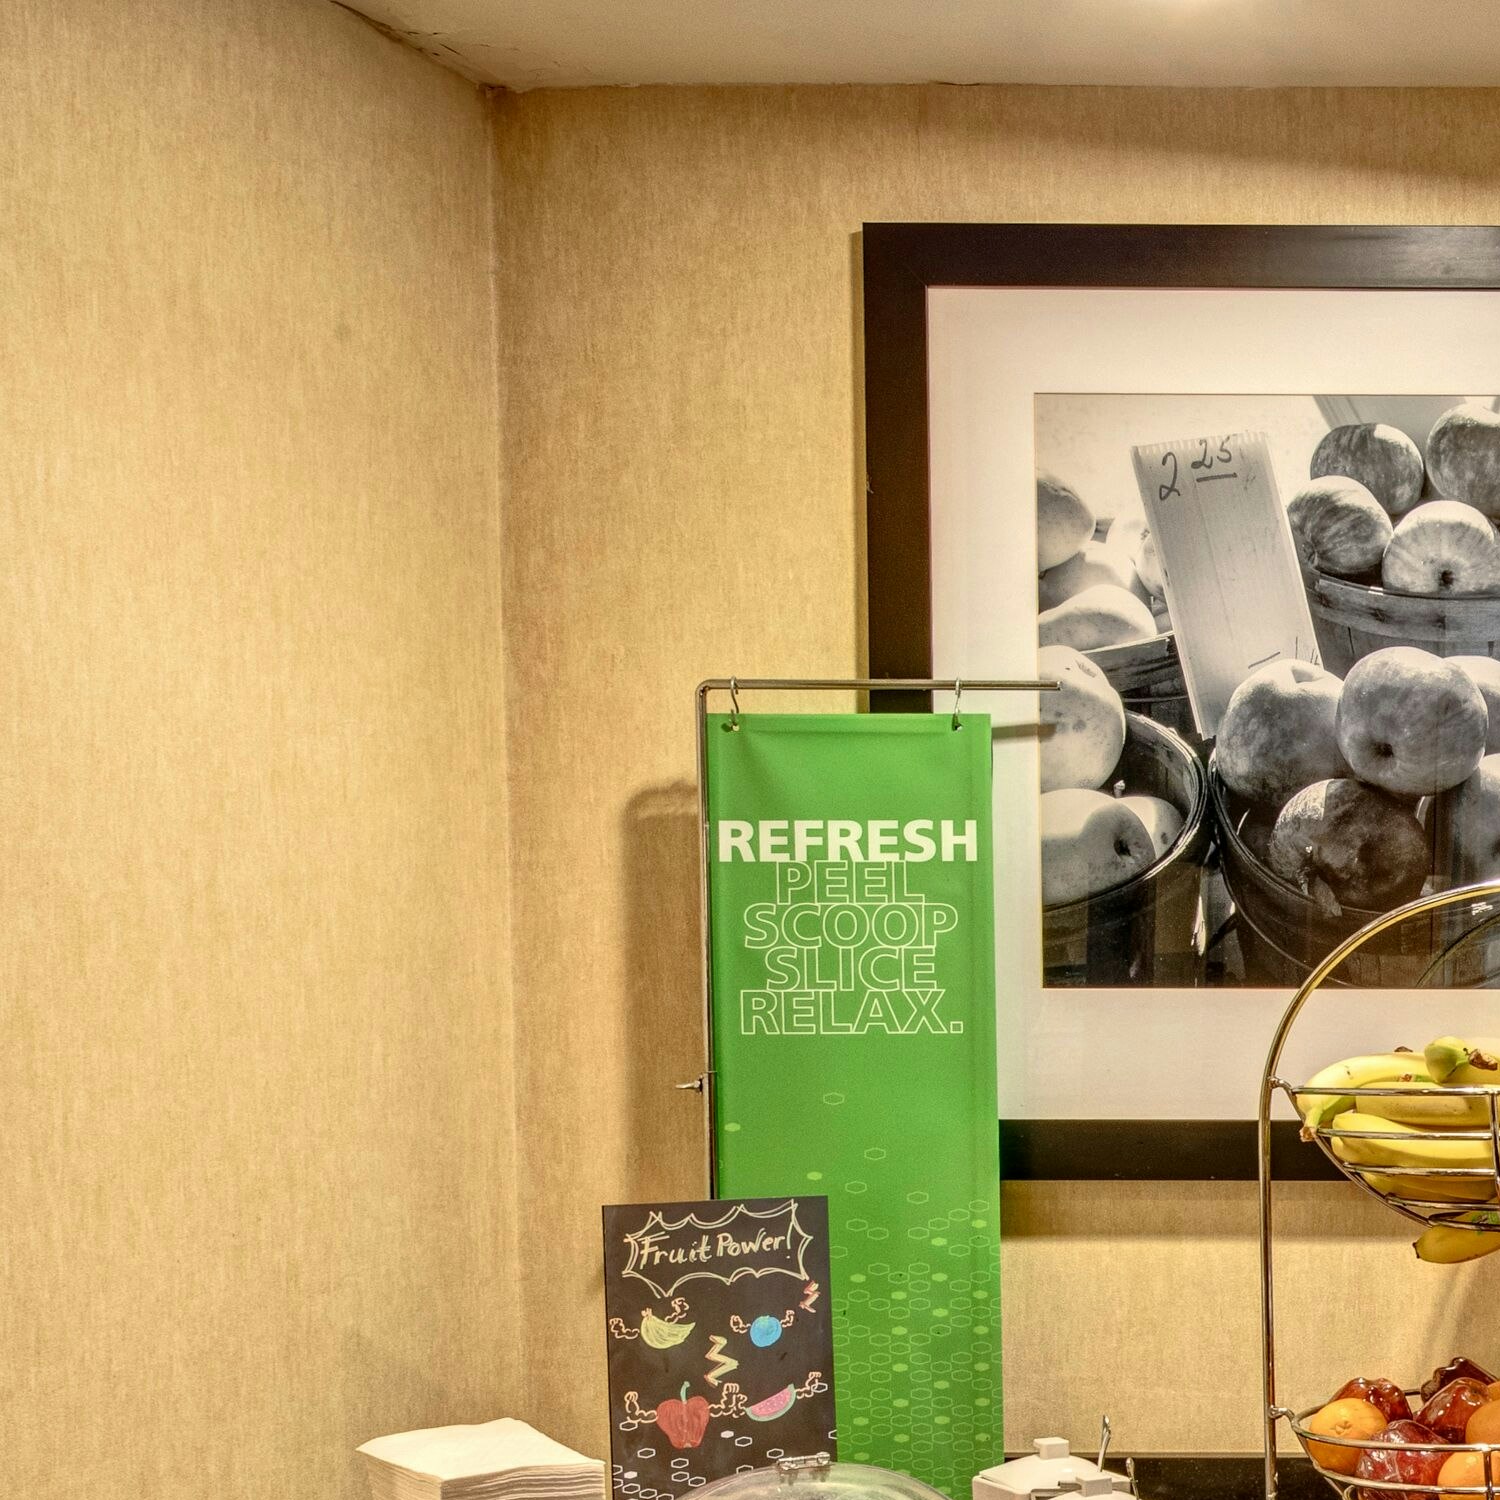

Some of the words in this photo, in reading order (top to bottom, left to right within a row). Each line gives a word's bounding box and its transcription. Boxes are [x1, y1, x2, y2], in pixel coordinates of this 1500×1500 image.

[718, 819, 978, 863] REFRESH
[776, 860, 925, 905] PEEL
[743, 903, 958, 949] SCOOP
[764, 946, 937, 992] SLICE
[740, 989, 964, 1035] RELAX.
[637, 1231, 713, 1269] Fruit
[716, 1220, 795, 1260] Power!
